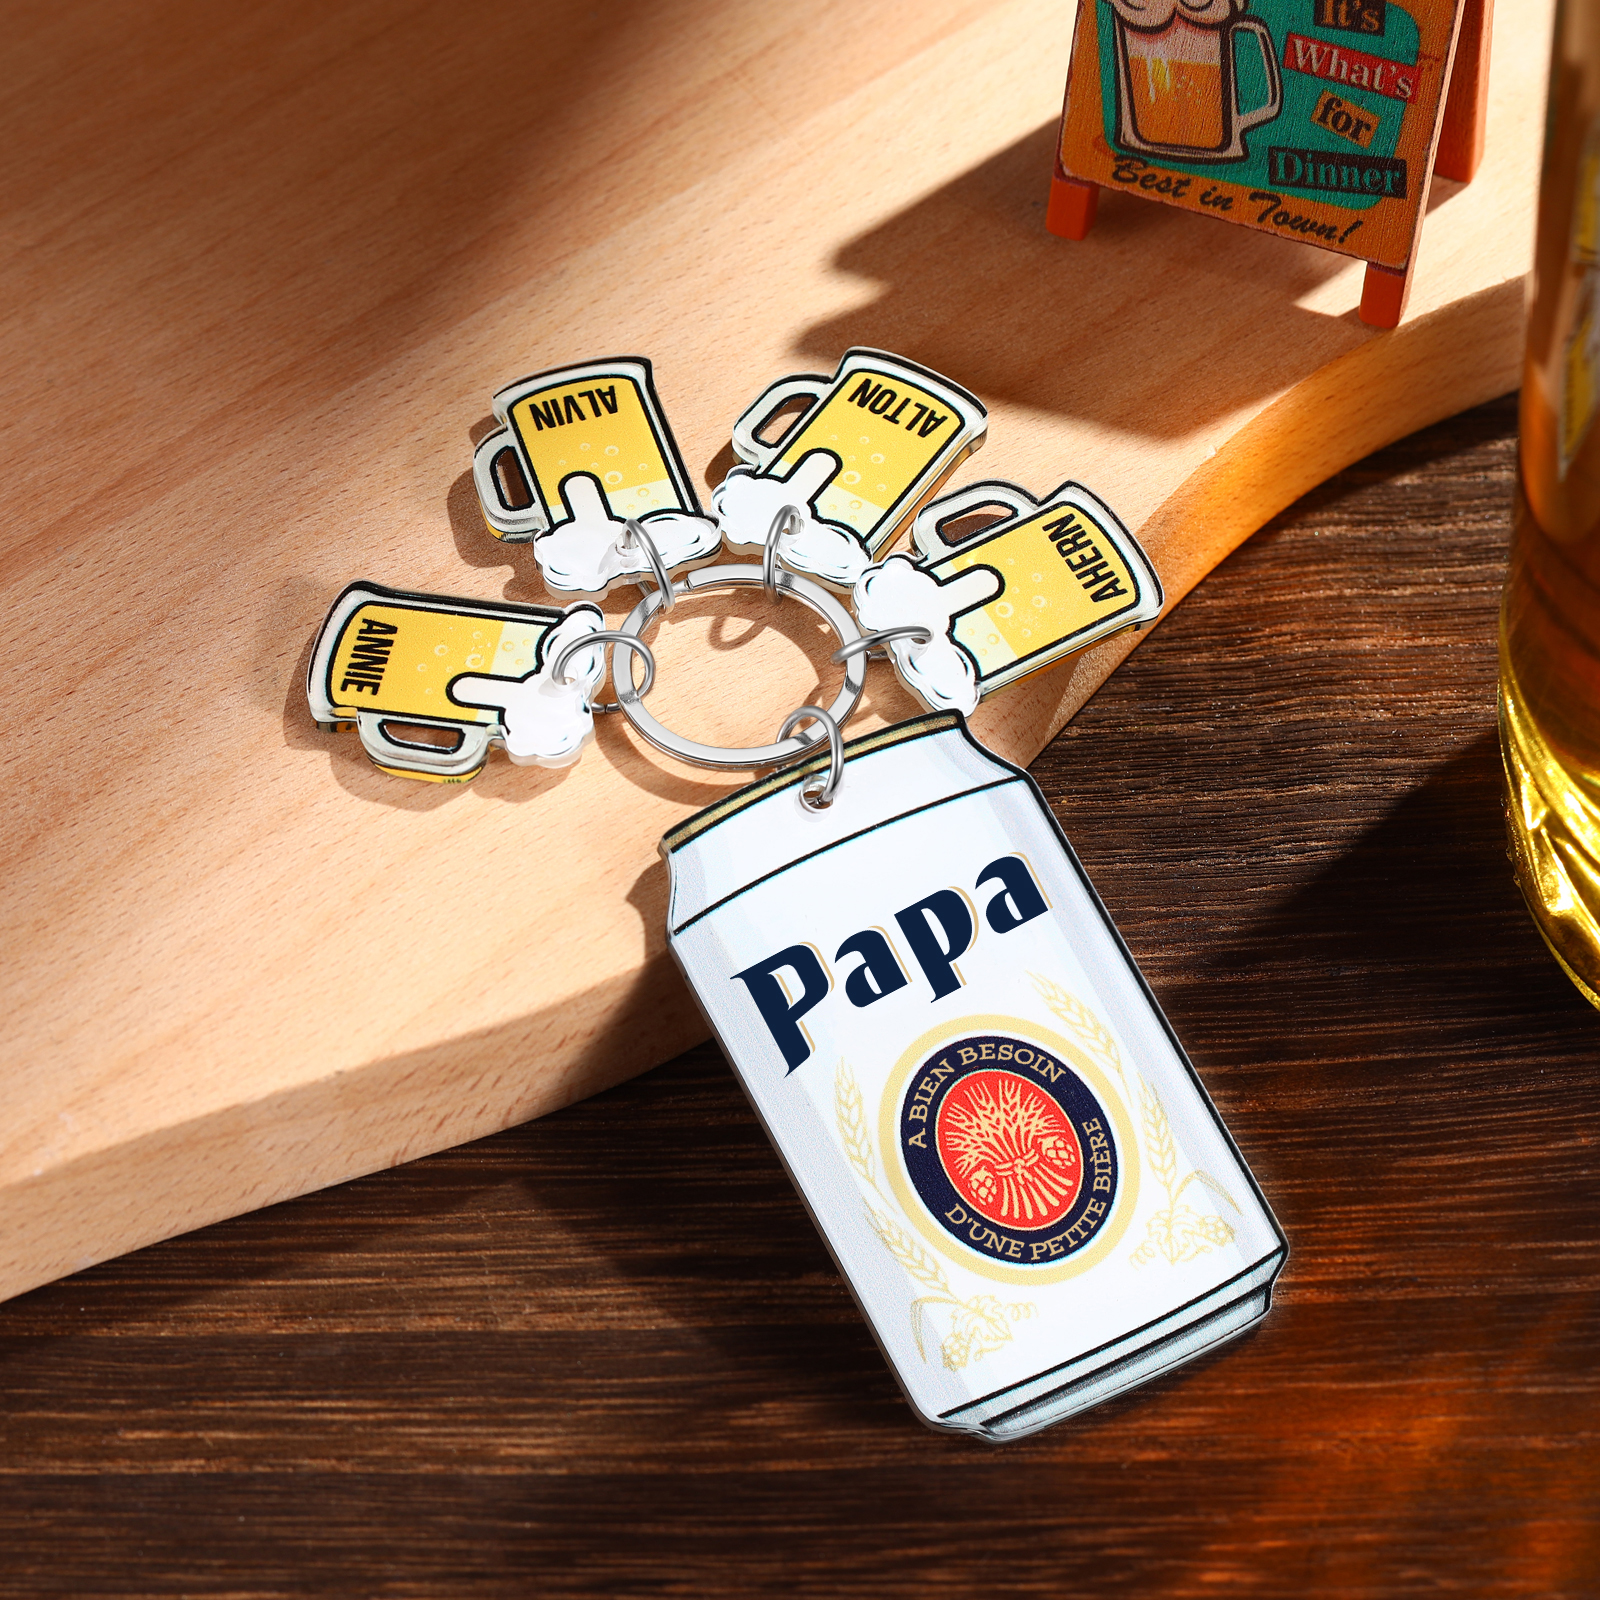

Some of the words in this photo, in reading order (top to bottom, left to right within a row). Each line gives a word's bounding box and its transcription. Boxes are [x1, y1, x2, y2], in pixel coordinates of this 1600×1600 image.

[1321, 0, 1380, 32] It's
[1292, 38, 1415, 100] What's
[1317, 94, 1373, 142] for
[1111, 156, 1192, 198] Best
[1199, 185, 1234, 212] in
[1248, 191, 1364, 244] Town!
[1273, 151, 1402, 196] Dinner
[528, 385, 619, 431] ALVIN
[847, 377, 949, 438] ALTON
[1041, 512, 1128, 603] AHERN
[340, 618, 398, 696] ANNIE
[730, 851, 1053, 1078] Papa
[908, 1058, 955, 1123] BIEN
[957, 1043, 1067, 1083] BESOIN
[908, 1128, 928, 1149] A
[945, 1203, 1025, 1259] D'UNE
[1029, 1197, 1107, 1261] PETITE
[1082, 1117, 1111, 1193] BIÈRE
